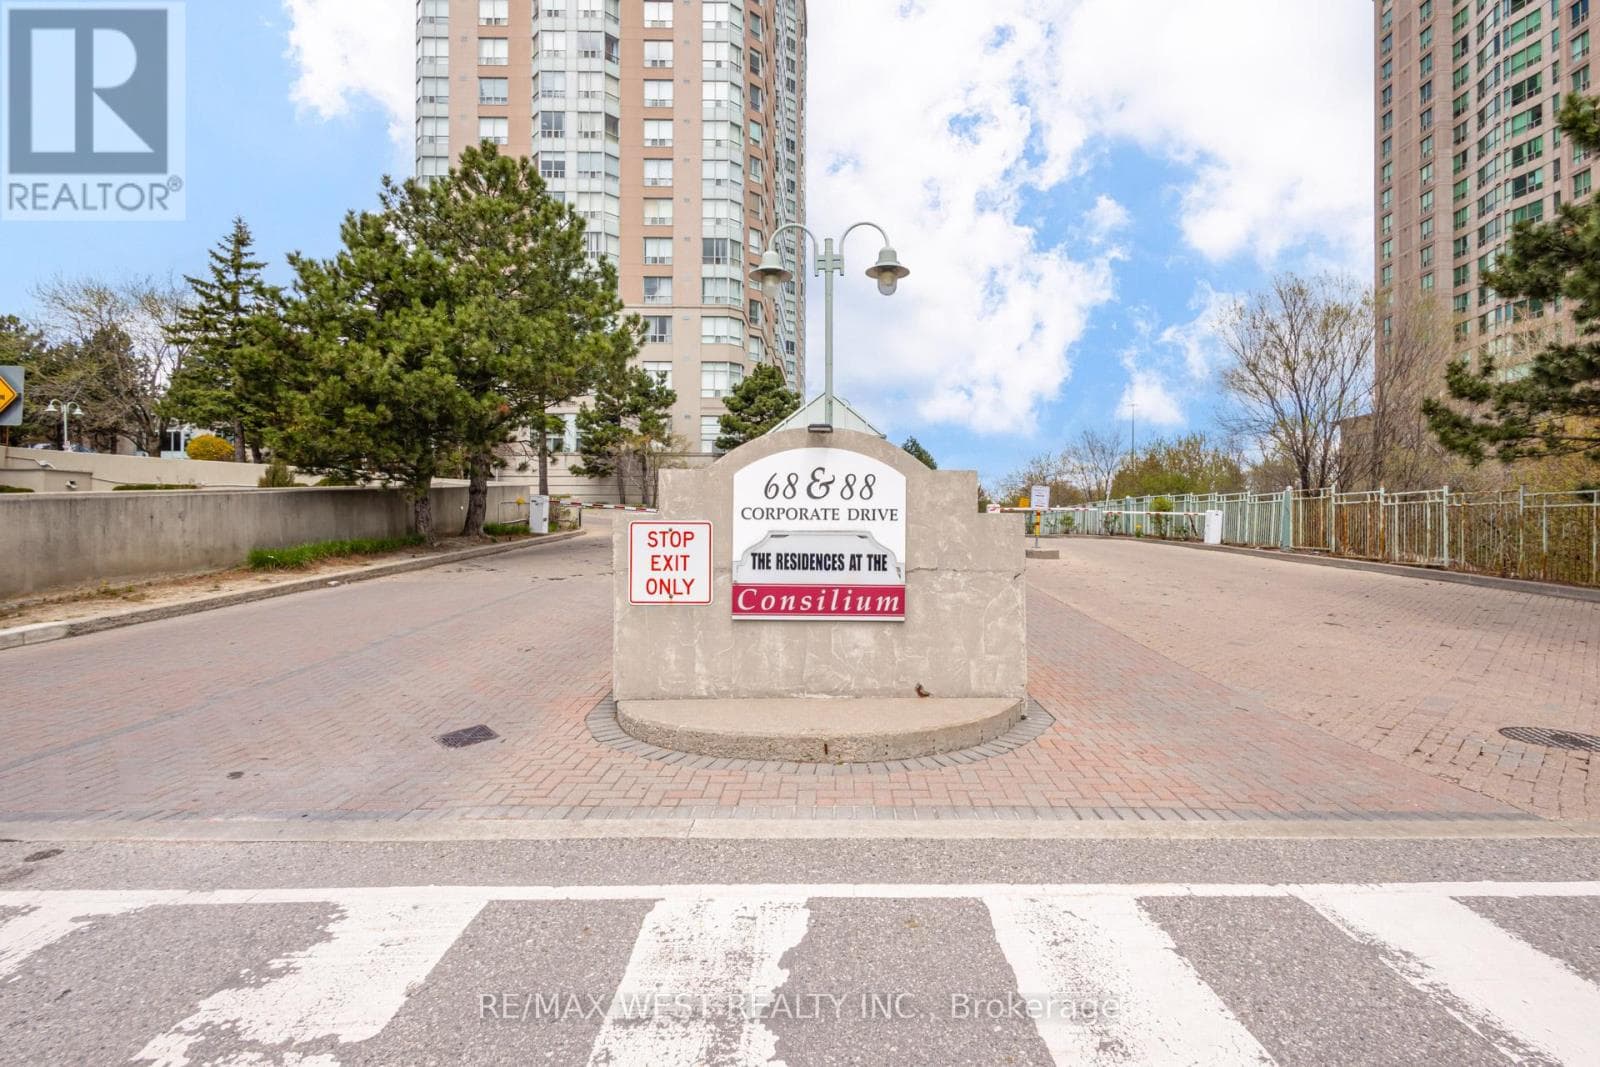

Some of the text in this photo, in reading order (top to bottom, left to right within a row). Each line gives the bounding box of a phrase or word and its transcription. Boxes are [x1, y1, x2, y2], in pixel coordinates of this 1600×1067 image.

[764, 466, 876, 501] 68 & 88
[741, 507, 899, 522] CORPORATE DRIVE
[647, 530, 695, 549] STOP
[651, 554, 689, 572] EXIT
[750, 552, 888, 572] THE RESIDENCES AT THE
[645, 577, 696, 597] ONLY
[737, 588, 900, 613] Consilium
